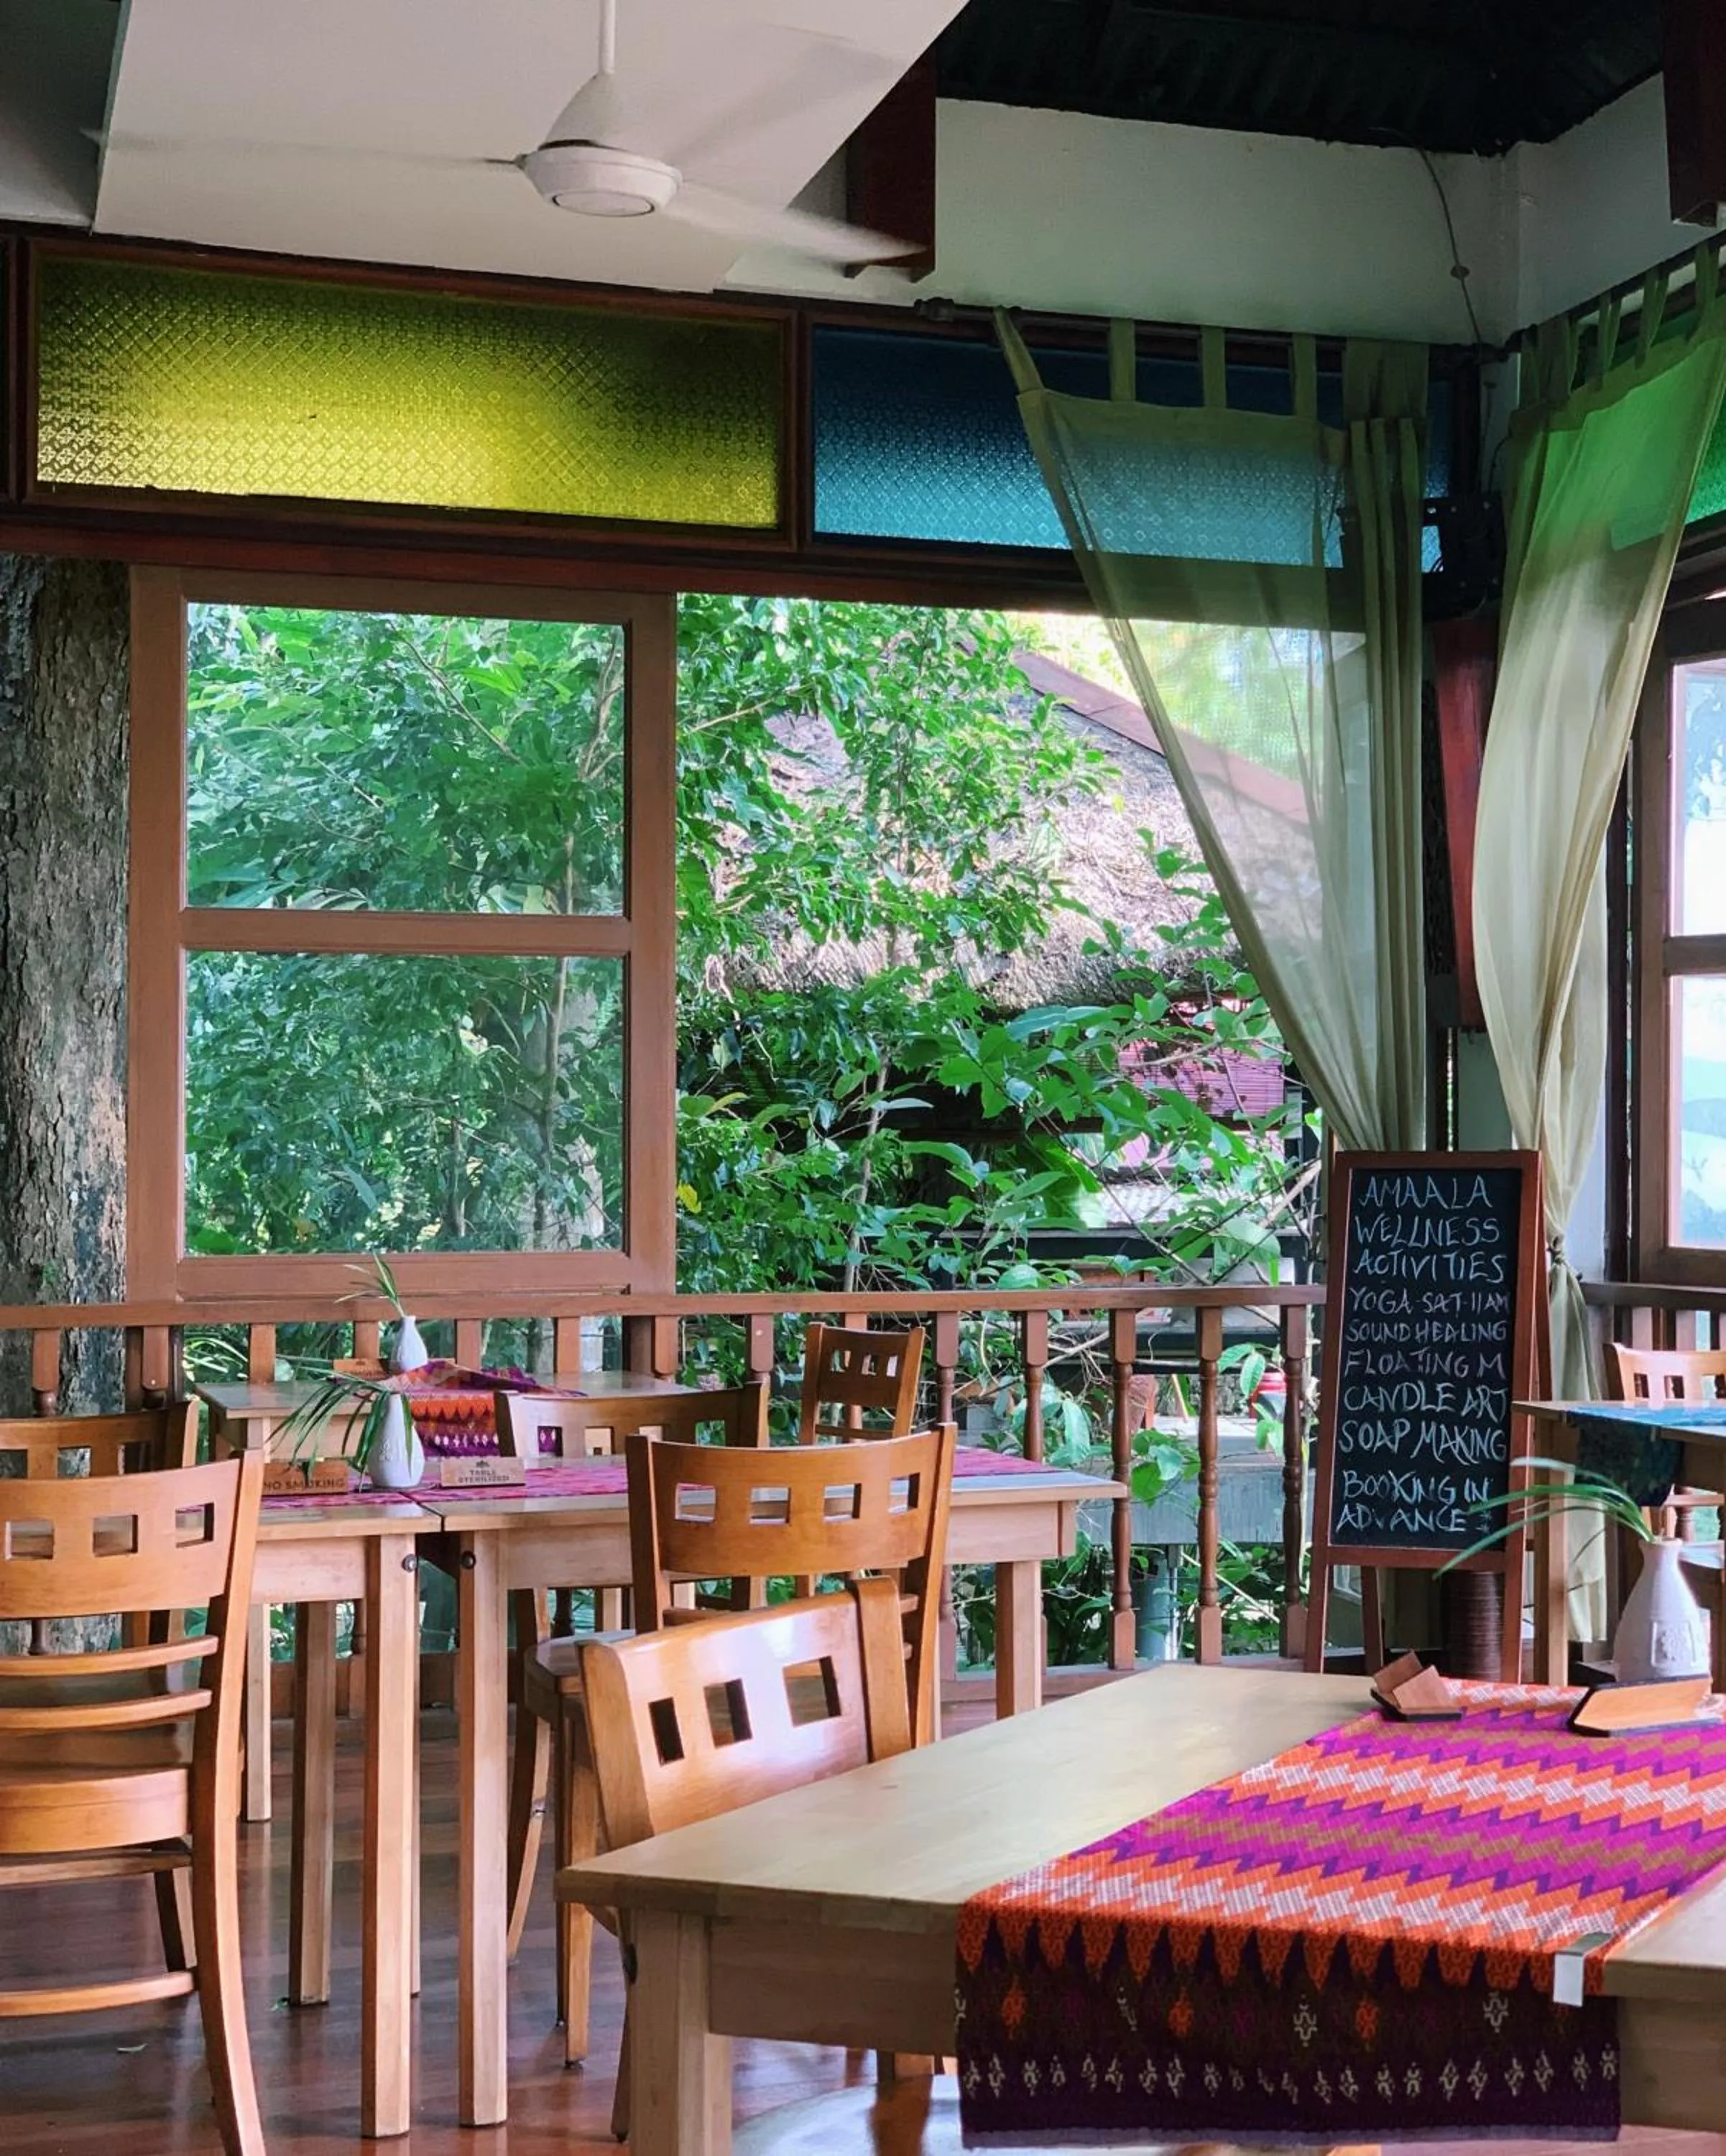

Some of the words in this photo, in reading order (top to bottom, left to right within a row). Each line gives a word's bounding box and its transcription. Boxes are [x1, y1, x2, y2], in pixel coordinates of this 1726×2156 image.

[1357, 1174, 1493, 1210] AMAALA
[1354, 1212, 1500, 1248] WELLNESS
[1353, 1248, 1507, 1284] ACTIVITIES
[1345, 1318, 1411, 1343] SOUND
[1414, 1318, 1508, 1343] HEALING
[1344, 1346, 1469, 1378] FLOATING
[1344, 1380, 1457, 1413] CANDLE
[1460, 1384, 1508, 1424] ART
[1339, 1417, 1411, 1454] SOAP
[1410, 1419, 1507, 1465] MAKING
[1342, 1470, 1457, 1506] BOOKING
[1463, 1477, 1491, 1503] IN
